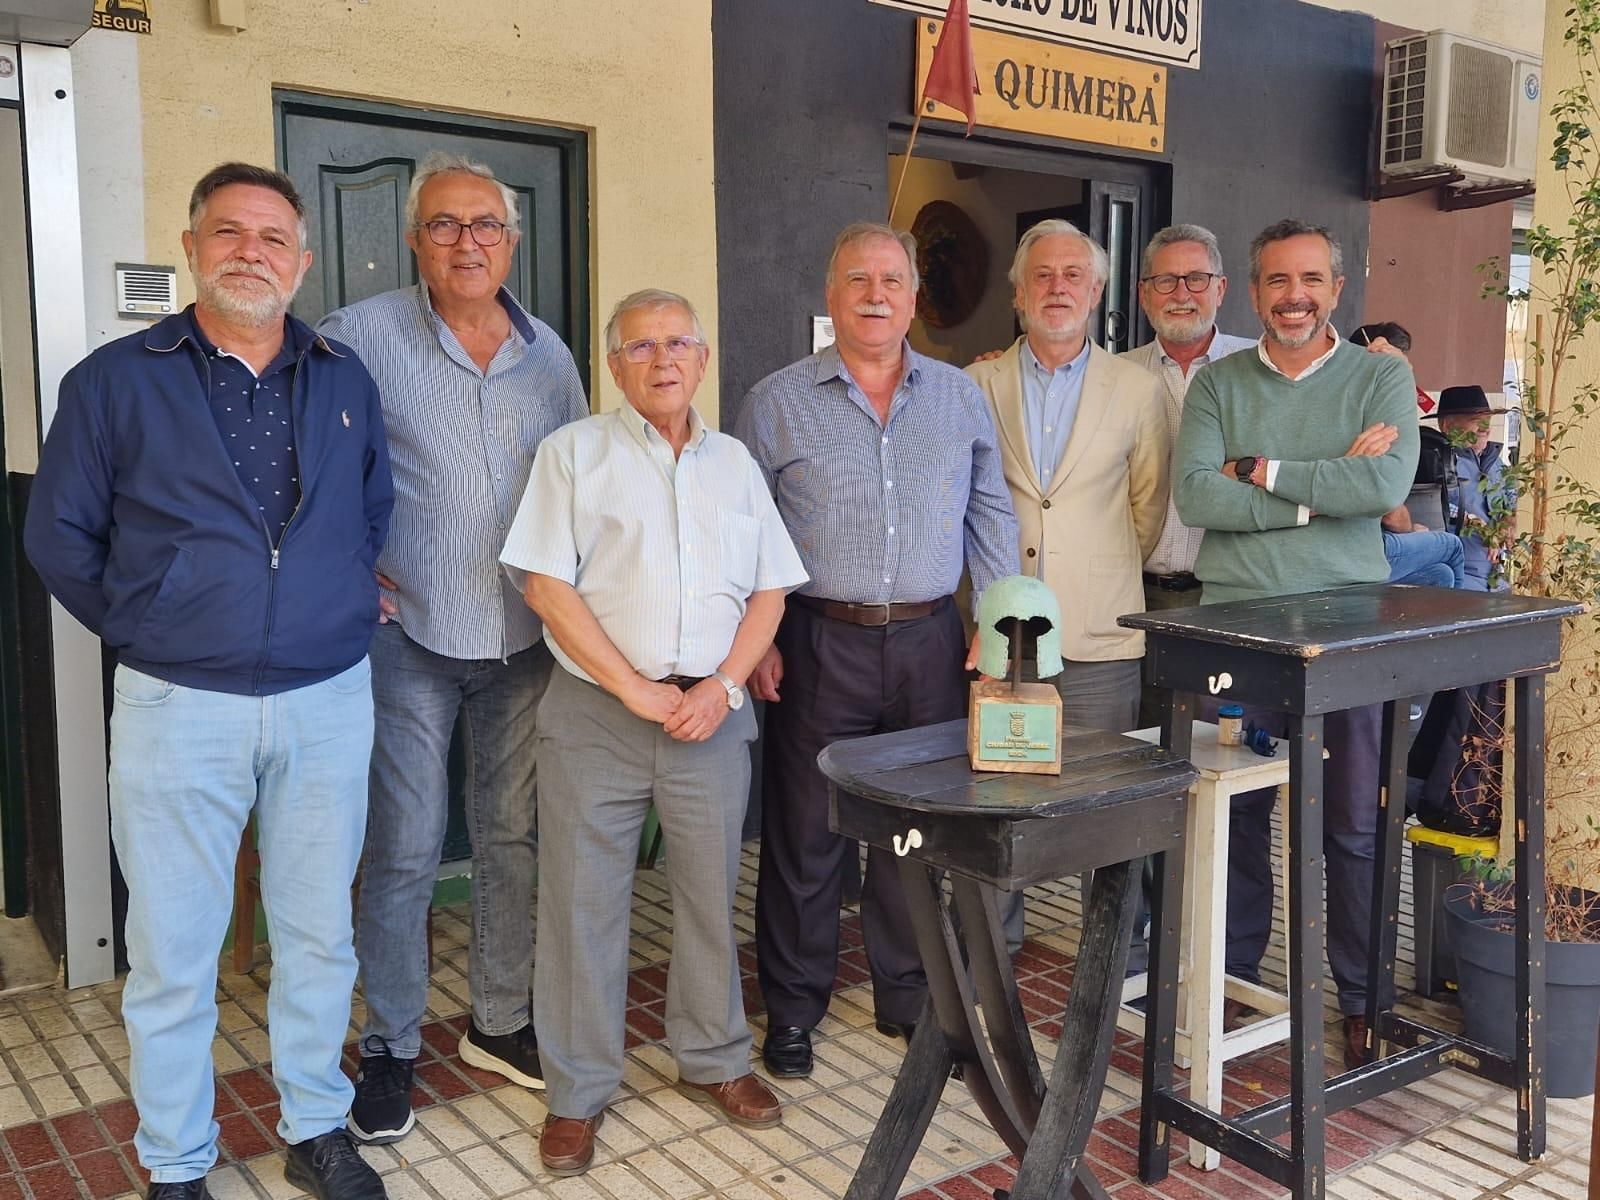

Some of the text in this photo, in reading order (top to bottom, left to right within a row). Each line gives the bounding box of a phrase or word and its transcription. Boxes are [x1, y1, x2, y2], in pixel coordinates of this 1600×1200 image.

[92, 13, 150, 33] SEGUR
[1109, 0, 1188, 45] VINOS
[994, 58, 1159, 126] QUIMERA
